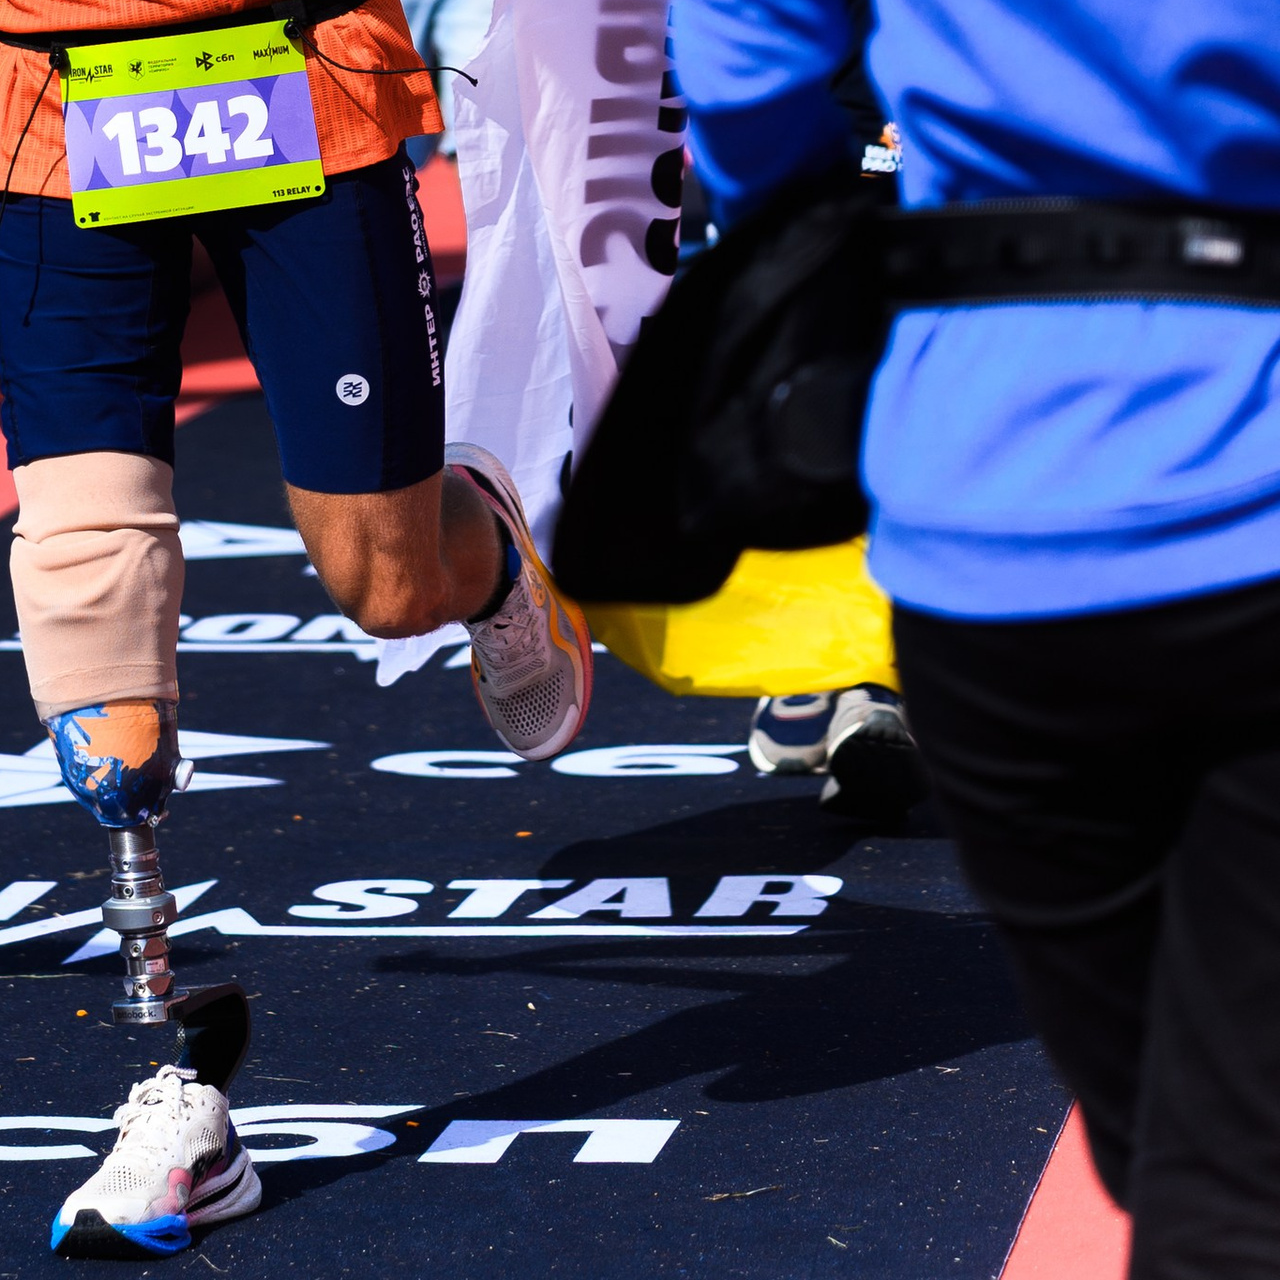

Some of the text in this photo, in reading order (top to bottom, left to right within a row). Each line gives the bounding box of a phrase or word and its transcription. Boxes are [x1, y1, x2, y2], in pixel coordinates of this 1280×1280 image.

[94, 64, 113, 75] STAR
[215, 54, 235, 63] сбп
[102, 95, 274, 176] 1342
[272, 185, 311, 198] 113 RELAY
[424, 304, 441, 387] ИНТЕР
[286, 874, 844, 921] STAR
